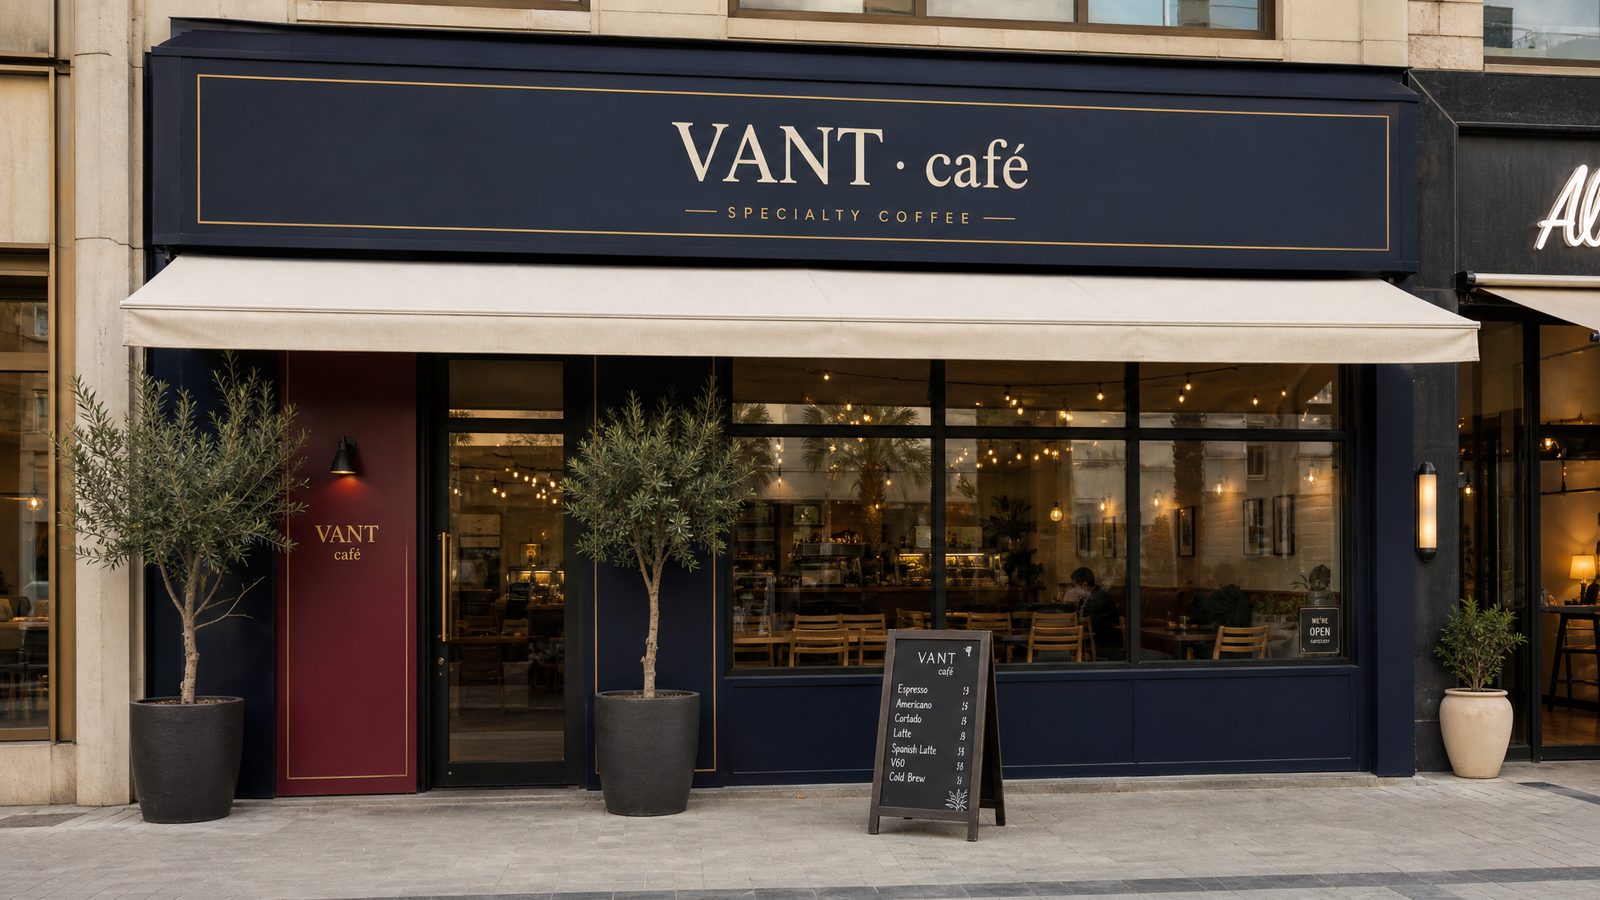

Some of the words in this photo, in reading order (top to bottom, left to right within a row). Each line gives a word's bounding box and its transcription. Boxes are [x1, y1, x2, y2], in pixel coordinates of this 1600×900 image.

[671, 121, 884, 186] VANT
[925, 138, 1028, 190] café
[728, 206, 860, 222] SPECIALTY
[878, 210, 969, 224] COFFEE
[315, 524, 379, 543] VANT
[334, 547, 361, 561] café
[1312, 616, 1328, 624] WE'RE
[1310, 627, 1330, 636] OPEN
[918, 652, 957, 665] VANT
[938, 667, 954, 677] café
[898, 684, 929, 697] Espresso
[896, 699, 933, 710] Americano
[895, 713, 922, 724] Cortado
[894, 728, 912, 739] Latte
[892, 743, 918, 757] Spanish
[920, 745, 937, 755] Latte
[891, 758, 906, 768] V60
[889, 772, 905, 782] Cold
[908, 773, 926, 783] Brew
